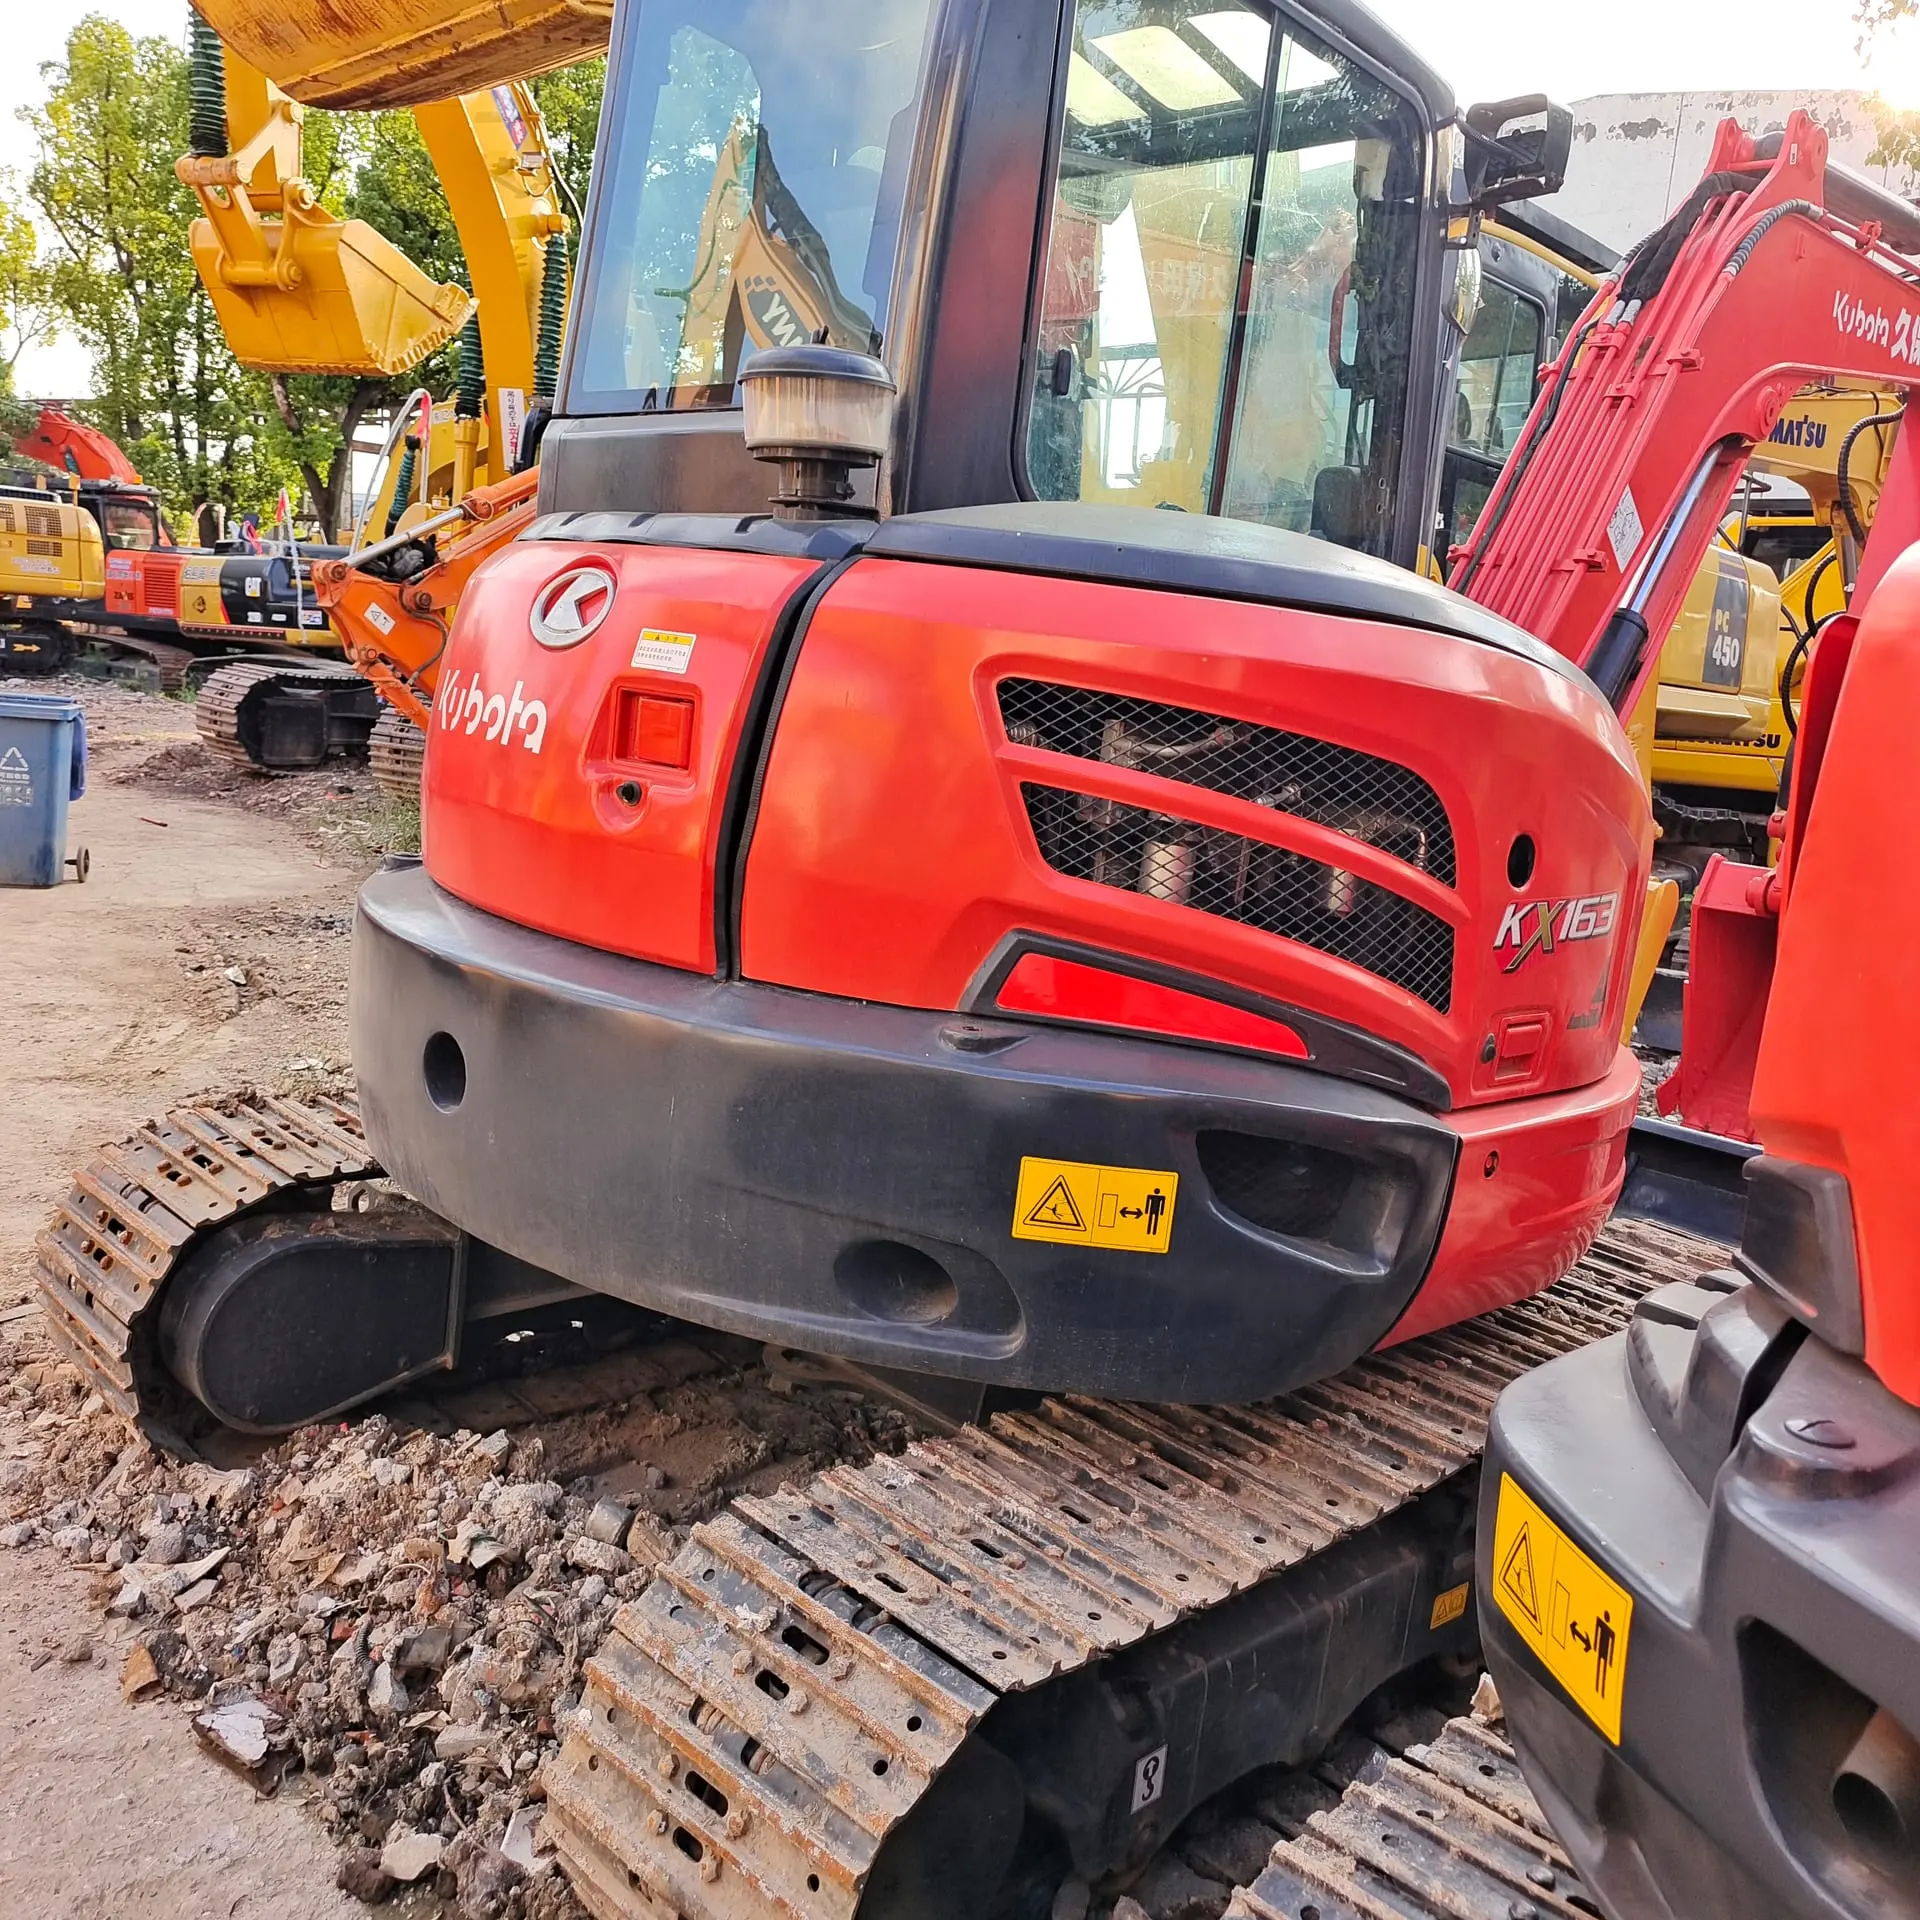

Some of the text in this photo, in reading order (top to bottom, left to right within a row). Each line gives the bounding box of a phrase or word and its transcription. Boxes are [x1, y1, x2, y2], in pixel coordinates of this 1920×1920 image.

[1833, 289, 1890, 348] Kubota
[1768, 415, 1827, 449] MATSU
[1714, 608, 1731, 634] PC
[1712, 634, 1740, 668] 450
[438, 668, 548, 755] Kubota
[1493, 889, 1618, 974] KX163
